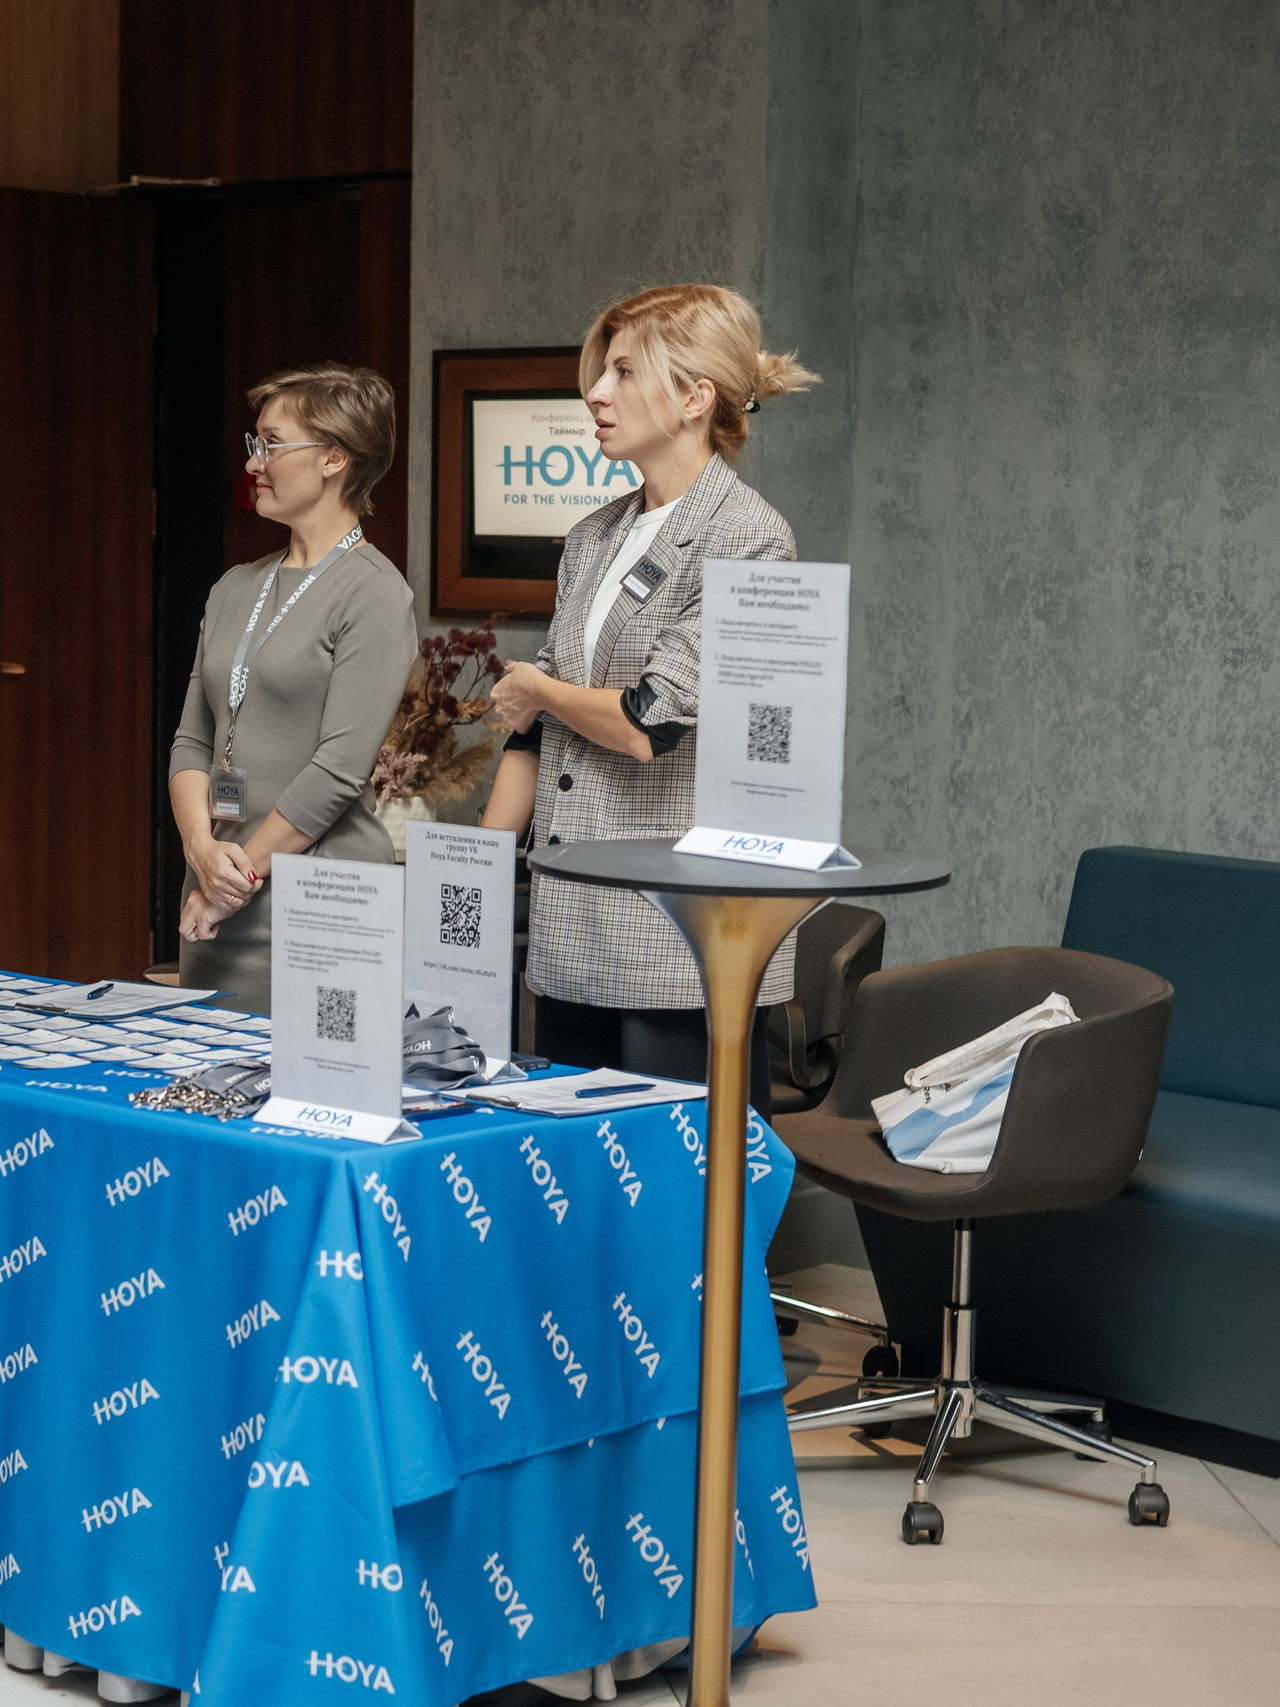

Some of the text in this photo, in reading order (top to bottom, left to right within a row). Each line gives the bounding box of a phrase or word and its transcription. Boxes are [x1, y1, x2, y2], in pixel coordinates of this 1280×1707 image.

[549, 426, 586, 437] Таймыр
[495, 445, 638, 488] HOYA
[504, 494, 527, 505] FOR
[534, 494, 555, 505] THE
[285, 574, 316, 605] HOYA
[639, 559, 662, 582] HOYA
[766, 575, 801, 587] участия
[245, 599, 266, 632] HOYA
[229, 663, 242, 707] HOYA
[217, 784, 240, 796] HOYA
[425, 831, 438, 840] Для
[439, 834, 476, 844] вступления
[482, 839, 500, 848] нашу
[431, 852, 494, 867] Hoya Faculty Россия:
[446, 844, 478, 854] группу VK
[722, 835, 785, 855] HOYA
[329, 871, 361, 881] участия
[25, 1080, 108, 1093] HOYA
[253, 1077, 272, 1092] HO
[297, 1107, 353, 1127] HOYA
[669, 1102, 707, 1176] HOY
[106, 1156, 170, 1207] HOYA
[519, 1134, 569, 1225] HOYA
[596, 1120, 642, 1208] HOYA
[228, 1184, 288, 1236] HOYA
[362, 1171, 411, 1266] HOYA
[440, 1152, 492, 1243] HOYA
[316, 1250, 365, 1281] HO
[100, 1268, 166, 1317] HOYA
[226, 1299, 281, 1349] HOYA
[612, 1292, 660, 1379] HOYA
[456, 1330, 511, 1420] HOYA
[540, 1310, 588, 1399] HOYA
[92, 1378, 160, 1425] HOYA
[247, 1460, 311, 1490] OYA
[81, 1487, 153, 1533] HOYA
[769, 1484, 810, 1572] HOYA
[355, 1558, 404, 1593] HO
[572, 1533, 605, 1620] HOYA
[625, 1512, 684, 1599] HOYA
[67, 1594, 142, 1639] HOYA
[483, 1552, 534, 1640] HOYA
[419, 1578, 454, 1667] HOYA
[304, 1650, 393, 1695] HOYA
